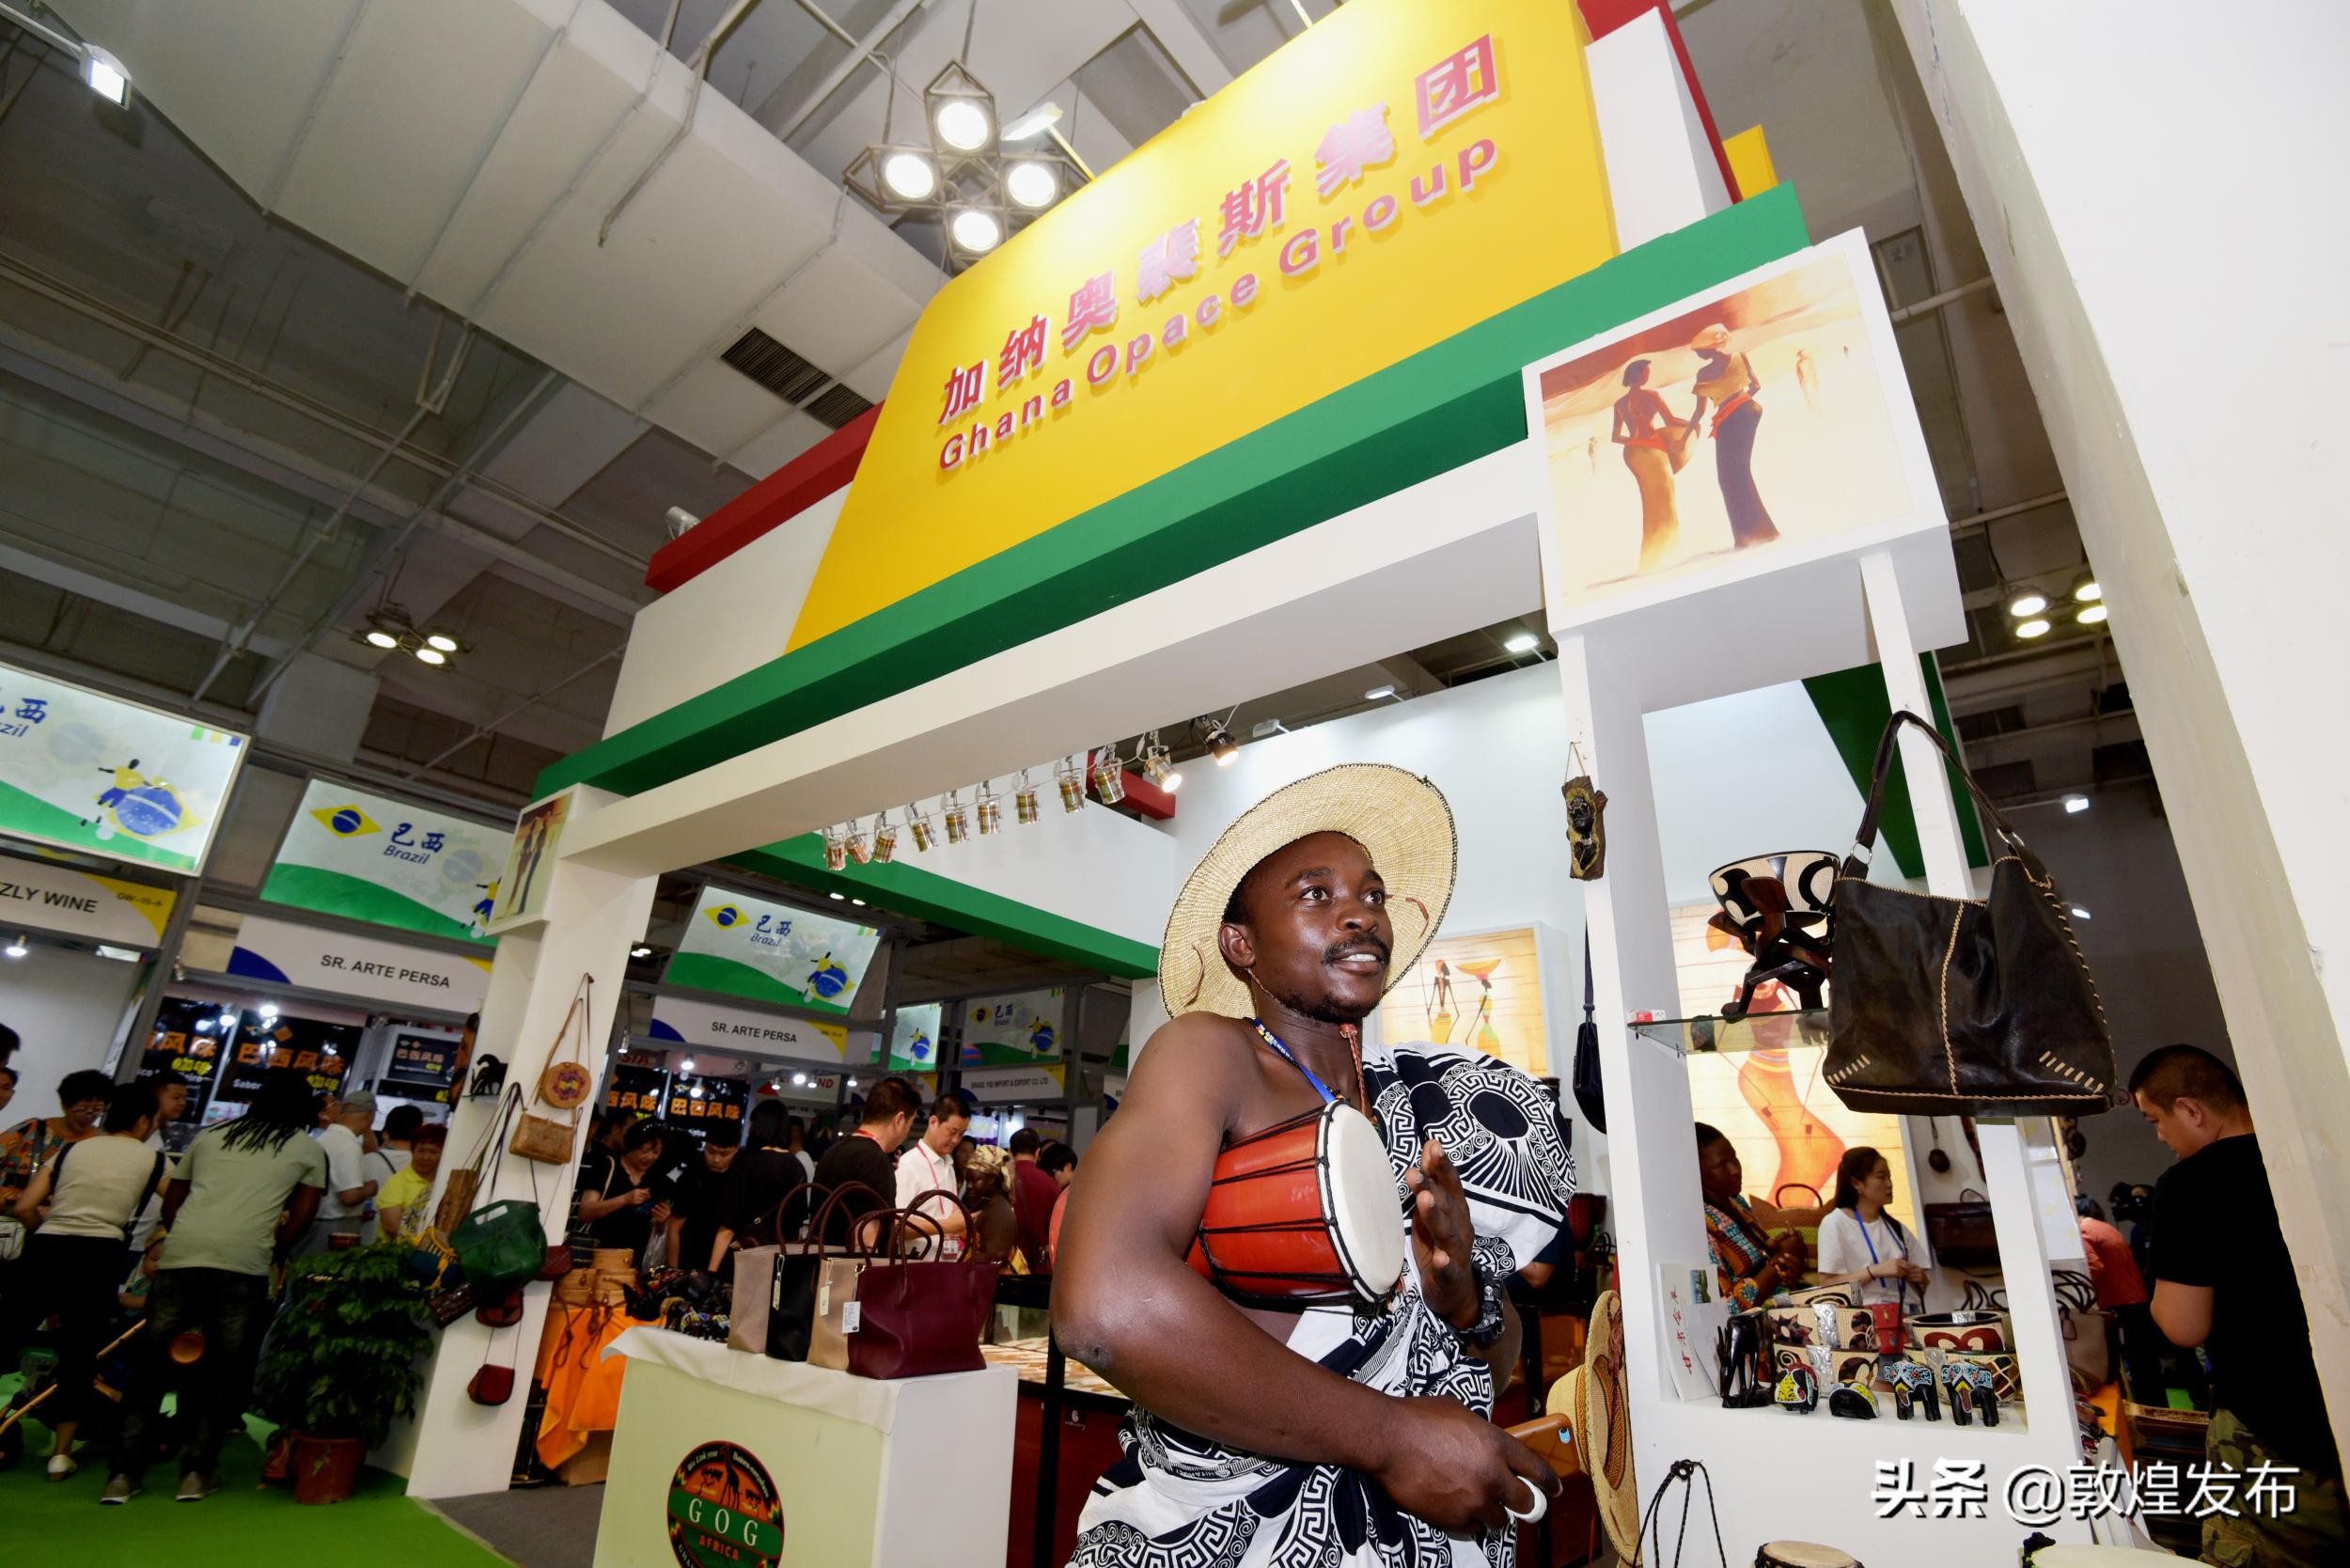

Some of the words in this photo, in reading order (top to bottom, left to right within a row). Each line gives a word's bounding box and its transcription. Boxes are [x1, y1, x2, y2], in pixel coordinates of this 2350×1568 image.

[939, 377, 1073, 471] Ghana
[1086, 273, 1258, 385] Opace
[1278, 137, 1498, 276] Group
[391, 823, 446, 853] 巴西
[384, 845, 431, 865] Brazil
[44, 890, 98, 914] WINE
[756, 914, 791, 937] 巴西
[750, 933, 781, 947] Brazil
[321, 954, 347, 970] SR.
[352, 961, 395, 979] ARTE
[399, 969, 450, 988] PERSA
[712, 1022, 728, 1034] SR.
[731, 1025, 760, 1039] ARTE
[763, 1029, 797, 1043] PERSA
[669, 1097, 742, 1121] 巴西风味
[698, 1534, 740, 1560] AFRICA
